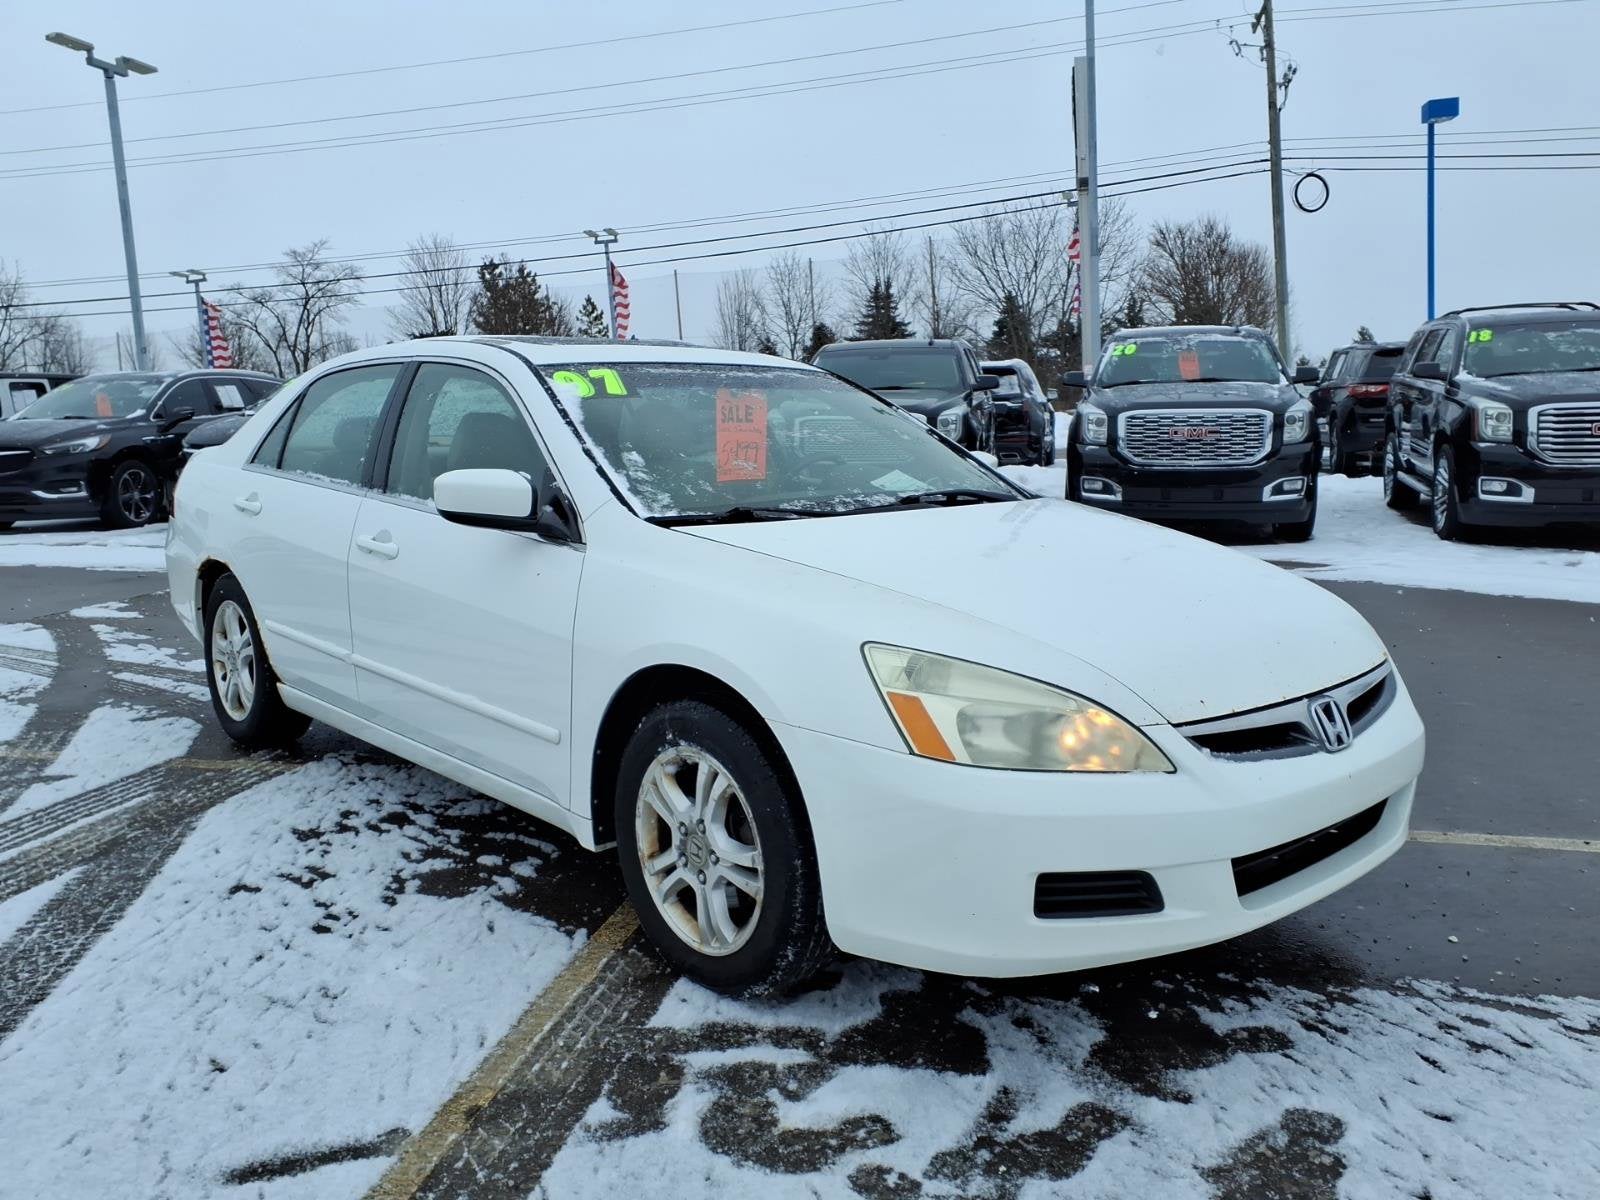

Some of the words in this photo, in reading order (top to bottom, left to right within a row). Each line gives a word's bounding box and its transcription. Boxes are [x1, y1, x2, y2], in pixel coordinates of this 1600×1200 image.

[1469, 329, 1493, 342] 18
[1112, 344, 1137, 356] 20
[720, 404, 754, 423] SALE
[1169, 426, 1221, 440] GMC
